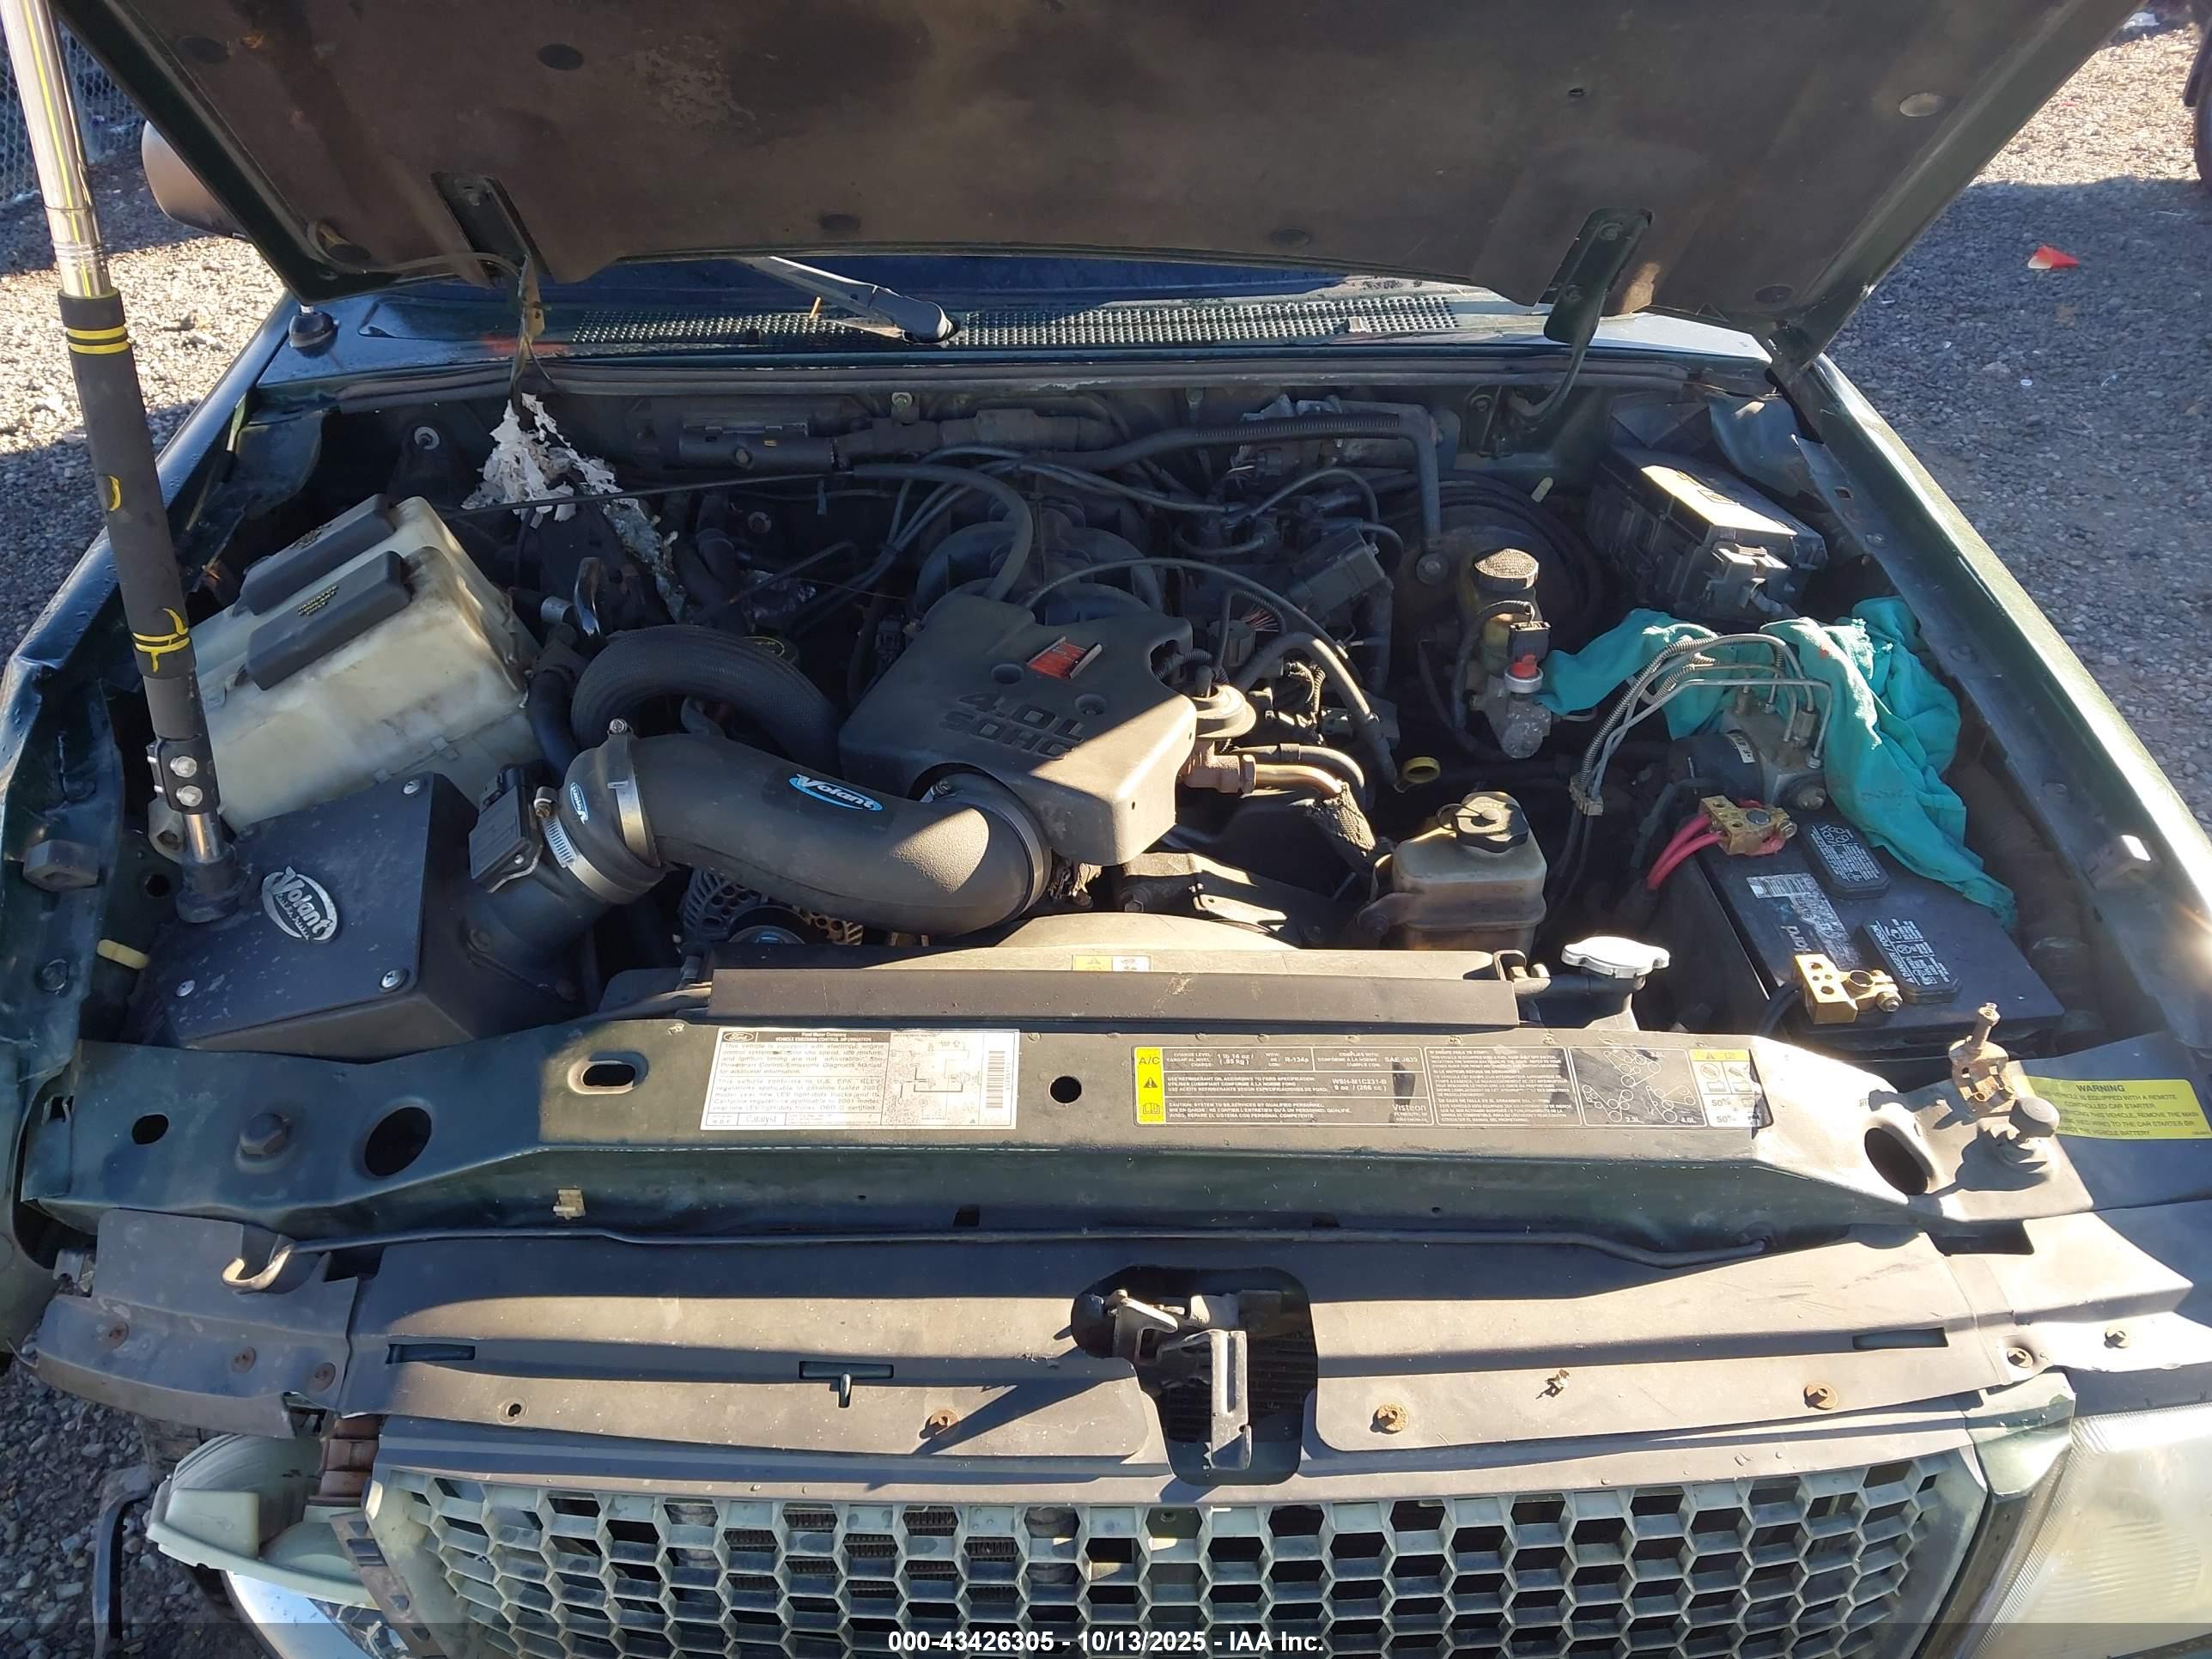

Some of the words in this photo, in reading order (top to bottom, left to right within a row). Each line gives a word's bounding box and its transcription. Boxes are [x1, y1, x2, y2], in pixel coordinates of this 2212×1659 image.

[939, 710, 1073, 761] SOHC
[957, 692, 1084, 742] 4.0L
[570, 785, 589, 824] Volant
[796, 773, 875, 809] Volant
[269, 866, 333, 934] Volant
[1870, 925, 1891, 946] POISON
[1889, 952, 1911, 977] DANGER
[1139, 1056, 1161, 1065] A/C
